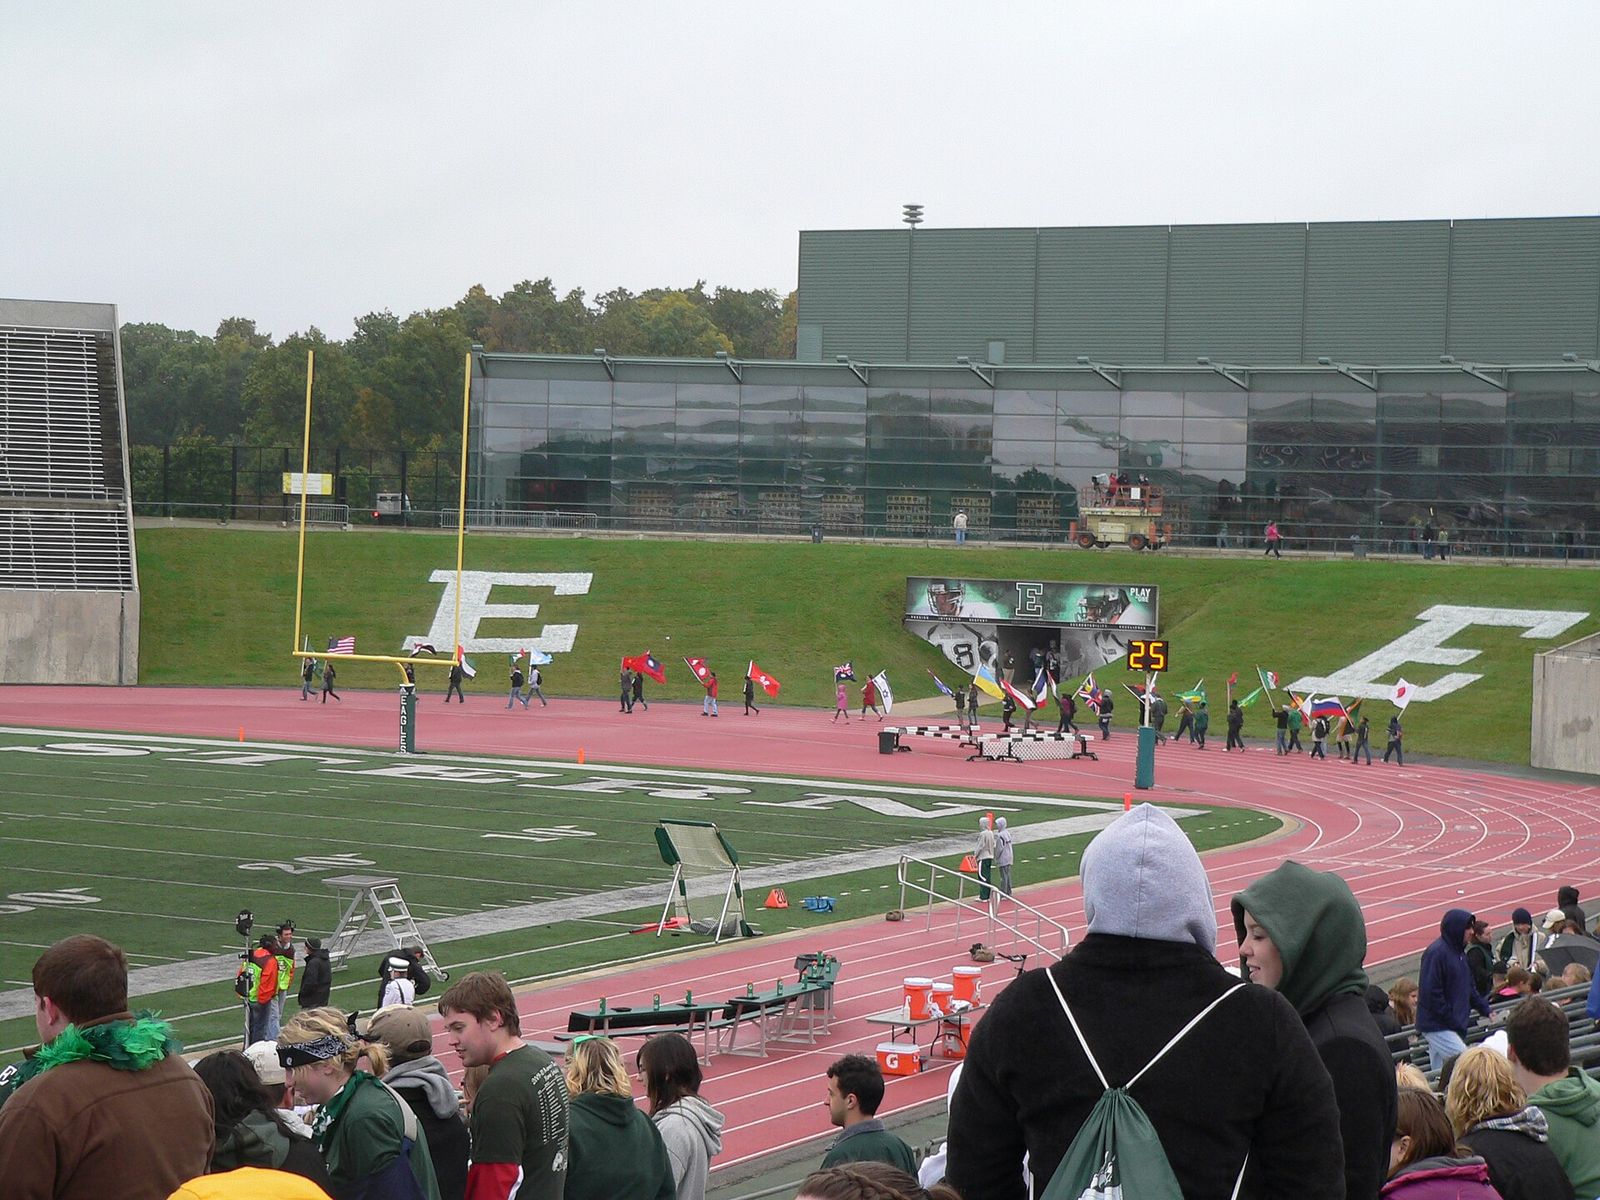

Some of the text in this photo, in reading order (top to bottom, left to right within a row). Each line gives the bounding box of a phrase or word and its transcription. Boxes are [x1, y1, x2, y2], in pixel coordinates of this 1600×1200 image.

[1016, 582, 1043, 617] E
[1130, 587, 1151, 597] PLAY
[1129, 641, 1165, 669] 25
[400, 695, 408, 754] EAGLES
[238, 856, 377, 874] 20
[886, 1054, 899, 1069] G
